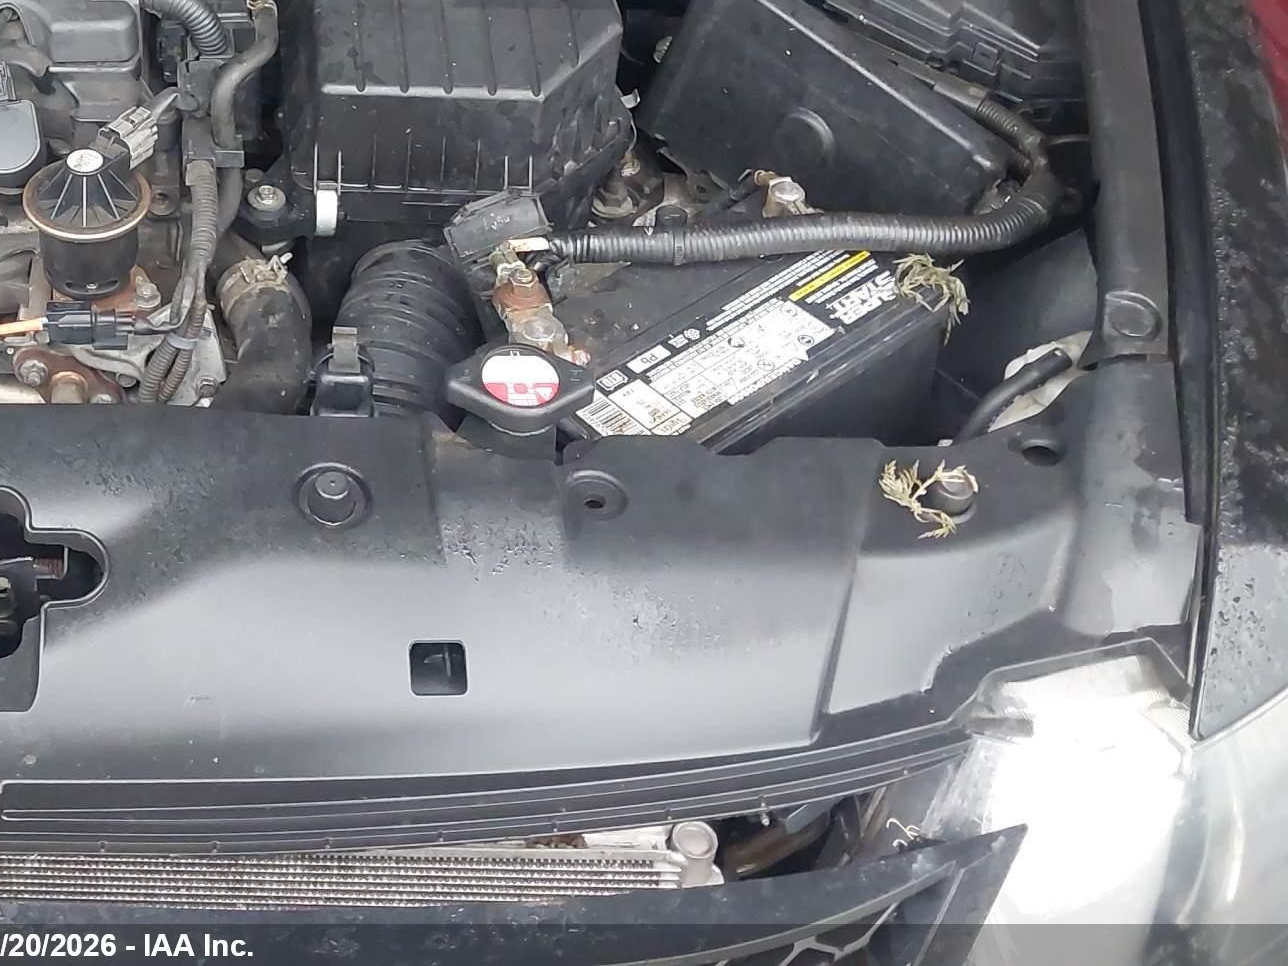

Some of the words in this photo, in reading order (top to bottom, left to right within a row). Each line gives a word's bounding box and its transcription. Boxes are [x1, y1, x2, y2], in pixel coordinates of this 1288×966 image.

[830, 269, 893, 315] START
[838, 288, 898, 325] SUPER
[639, 353, 658, 365] Pb
